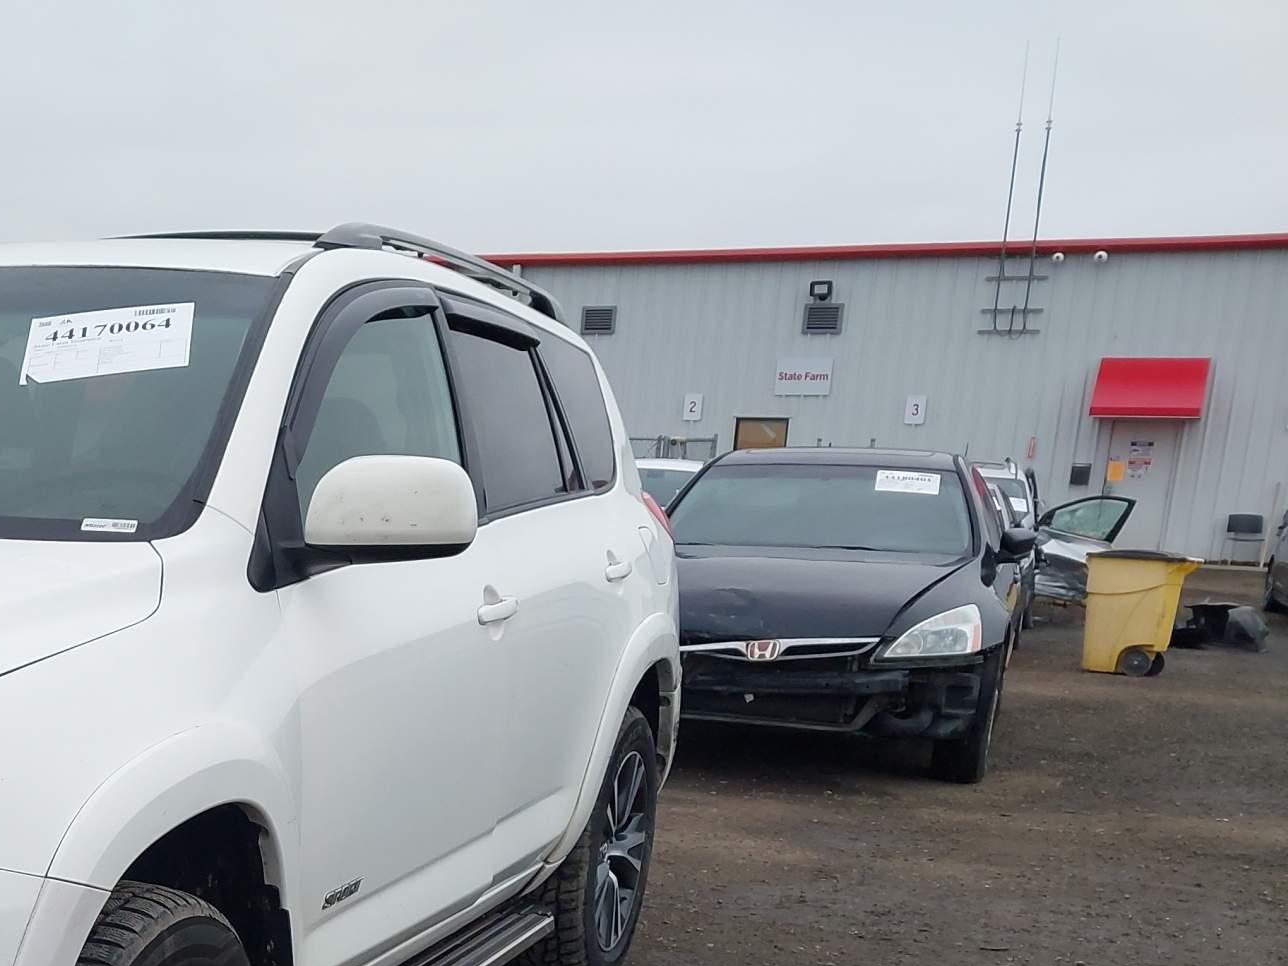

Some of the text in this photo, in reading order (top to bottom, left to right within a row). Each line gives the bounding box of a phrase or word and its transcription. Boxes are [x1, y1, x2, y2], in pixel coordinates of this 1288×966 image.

[45, 317, 172, 342] 44170064
[778, 372, 829, 381] State Farm
[689, 401, 697, 413] 2
[911, 404, 920, 416] 3
